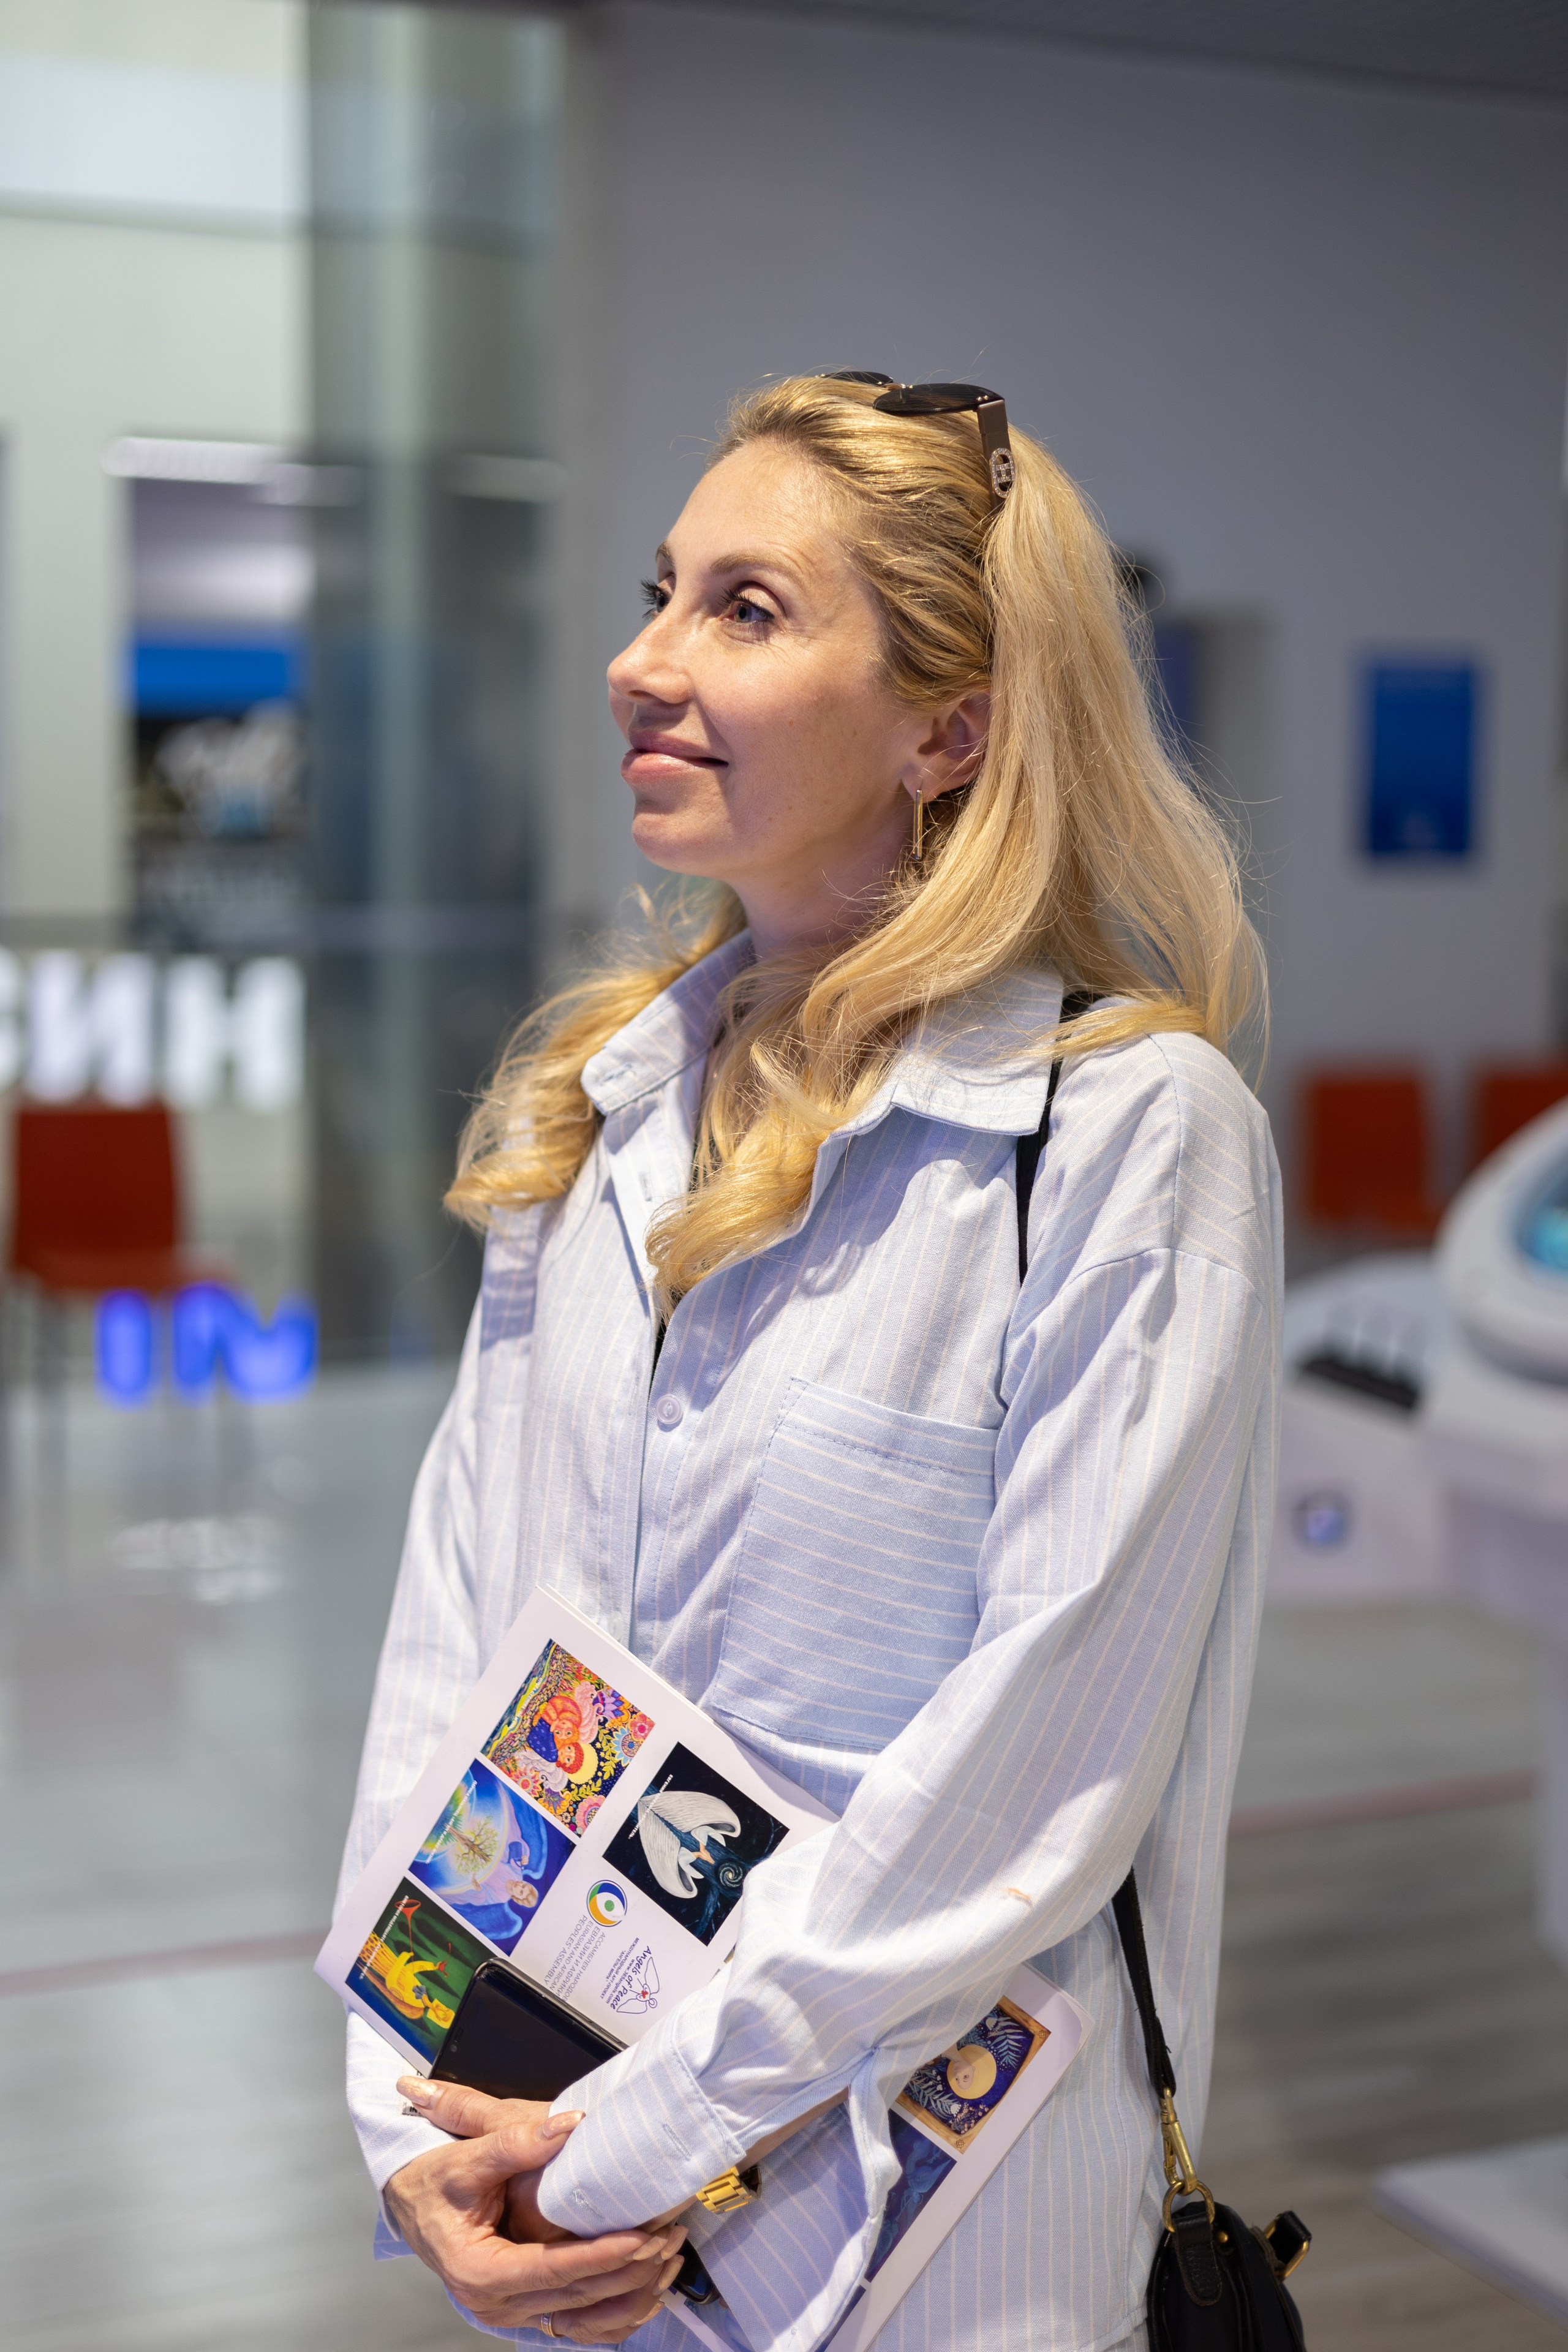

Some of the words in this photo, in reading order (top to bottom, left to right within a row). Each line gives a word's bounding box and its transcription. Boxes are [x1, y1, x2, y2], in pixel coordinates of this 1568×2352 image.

[658, 1774, 673, 1793] ЕВГЕНИЯ
[573, 1921, 594, 1951] EURASIAN
[578, 1926, 600, 1959] ЕВРАЗИИ
[581, 1932, 605, 1970] АССАМБЛЕЯ
[543, 1947, 567, 1985] ASSEMBLY
[565, 1950, 575, 1964] AND
[615, 1937, 639, 1975] МЕЖДУНАРОДНЫЙ
[631, 1946, 651, 1975] Angels
[549, 1964, 566, 1990] AFRICAN
[556, 1966, 575, 1996] АФРИКИ
[560, 1970, 582, 2002] НАРОДОВ
[600, 1974, 616, 1999] АРТ-ПРОЕКТ
[606, 1959, 635, 2003] www.365angels.com
[625, 1975, 633, 1988] of
[610, 1985, 628, 2010] Peace
